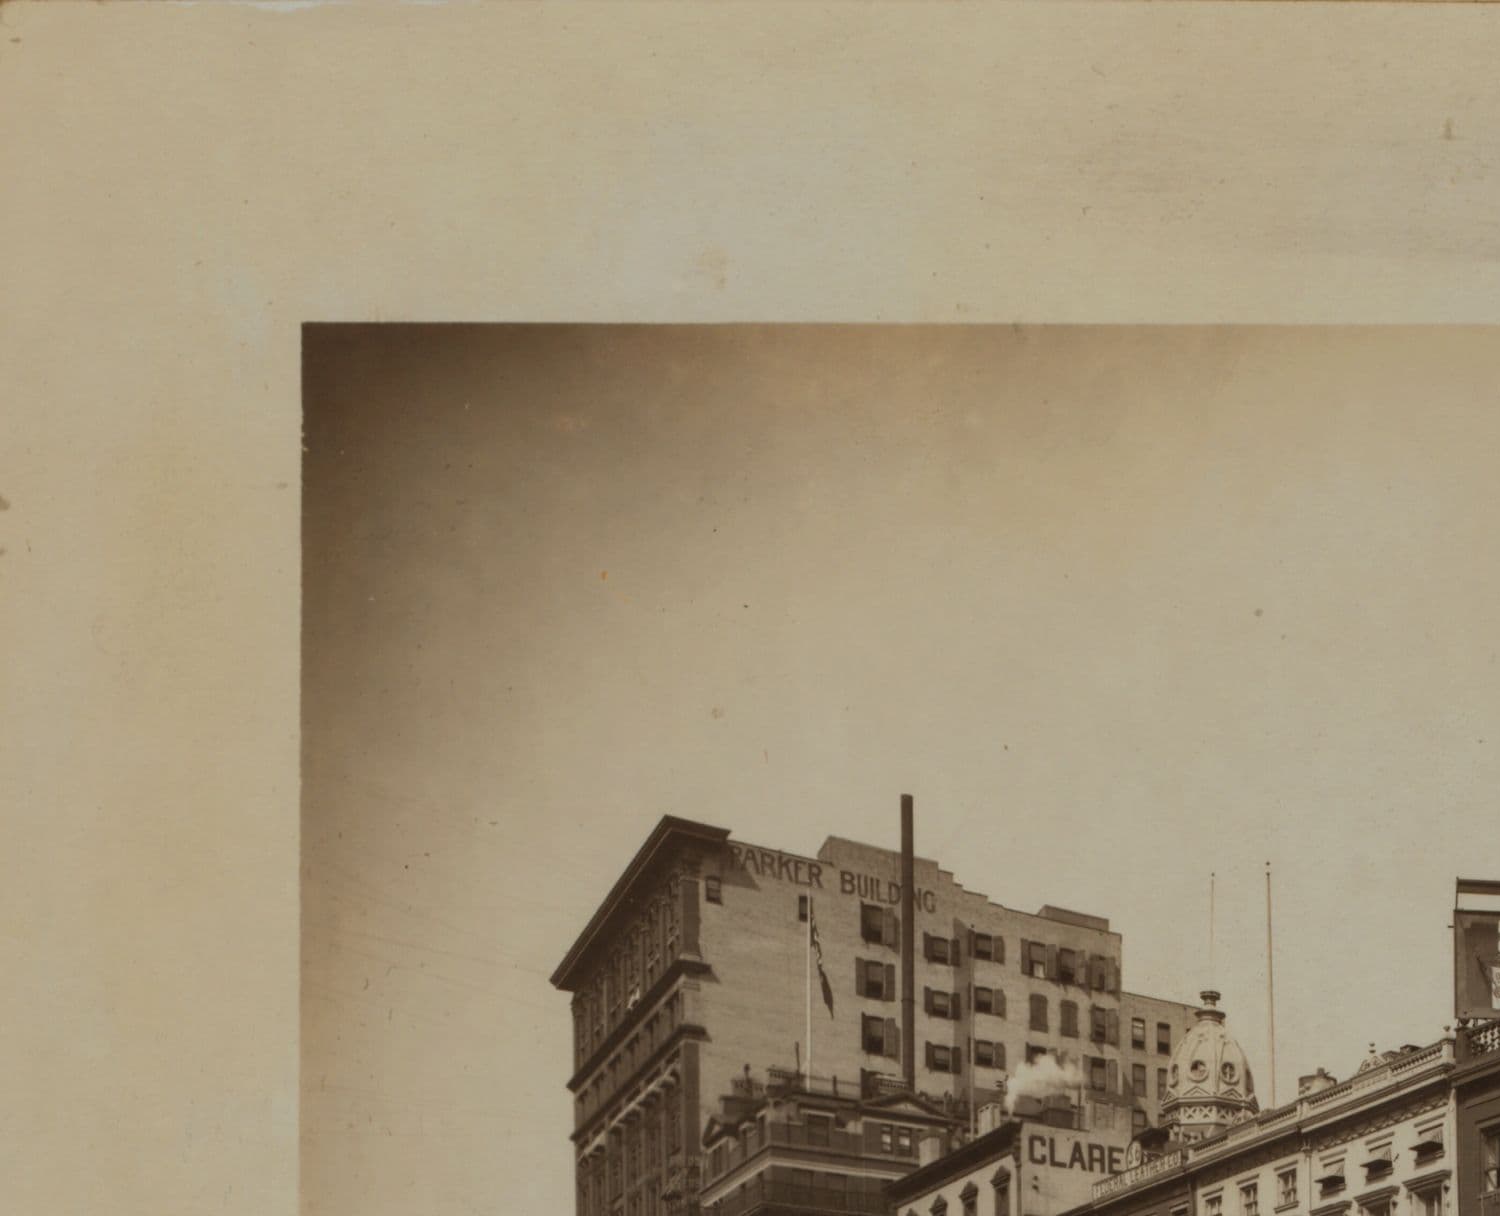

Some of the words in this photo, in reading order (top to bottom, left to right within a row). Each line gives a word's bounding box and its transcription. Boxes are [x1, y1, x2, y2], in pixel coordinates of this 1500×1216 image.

[731, 846, 824, 889] PARKER
[839, 869, 937, 914] BUILDNG
[1029, 1135, 1127, 1175] CLARE
